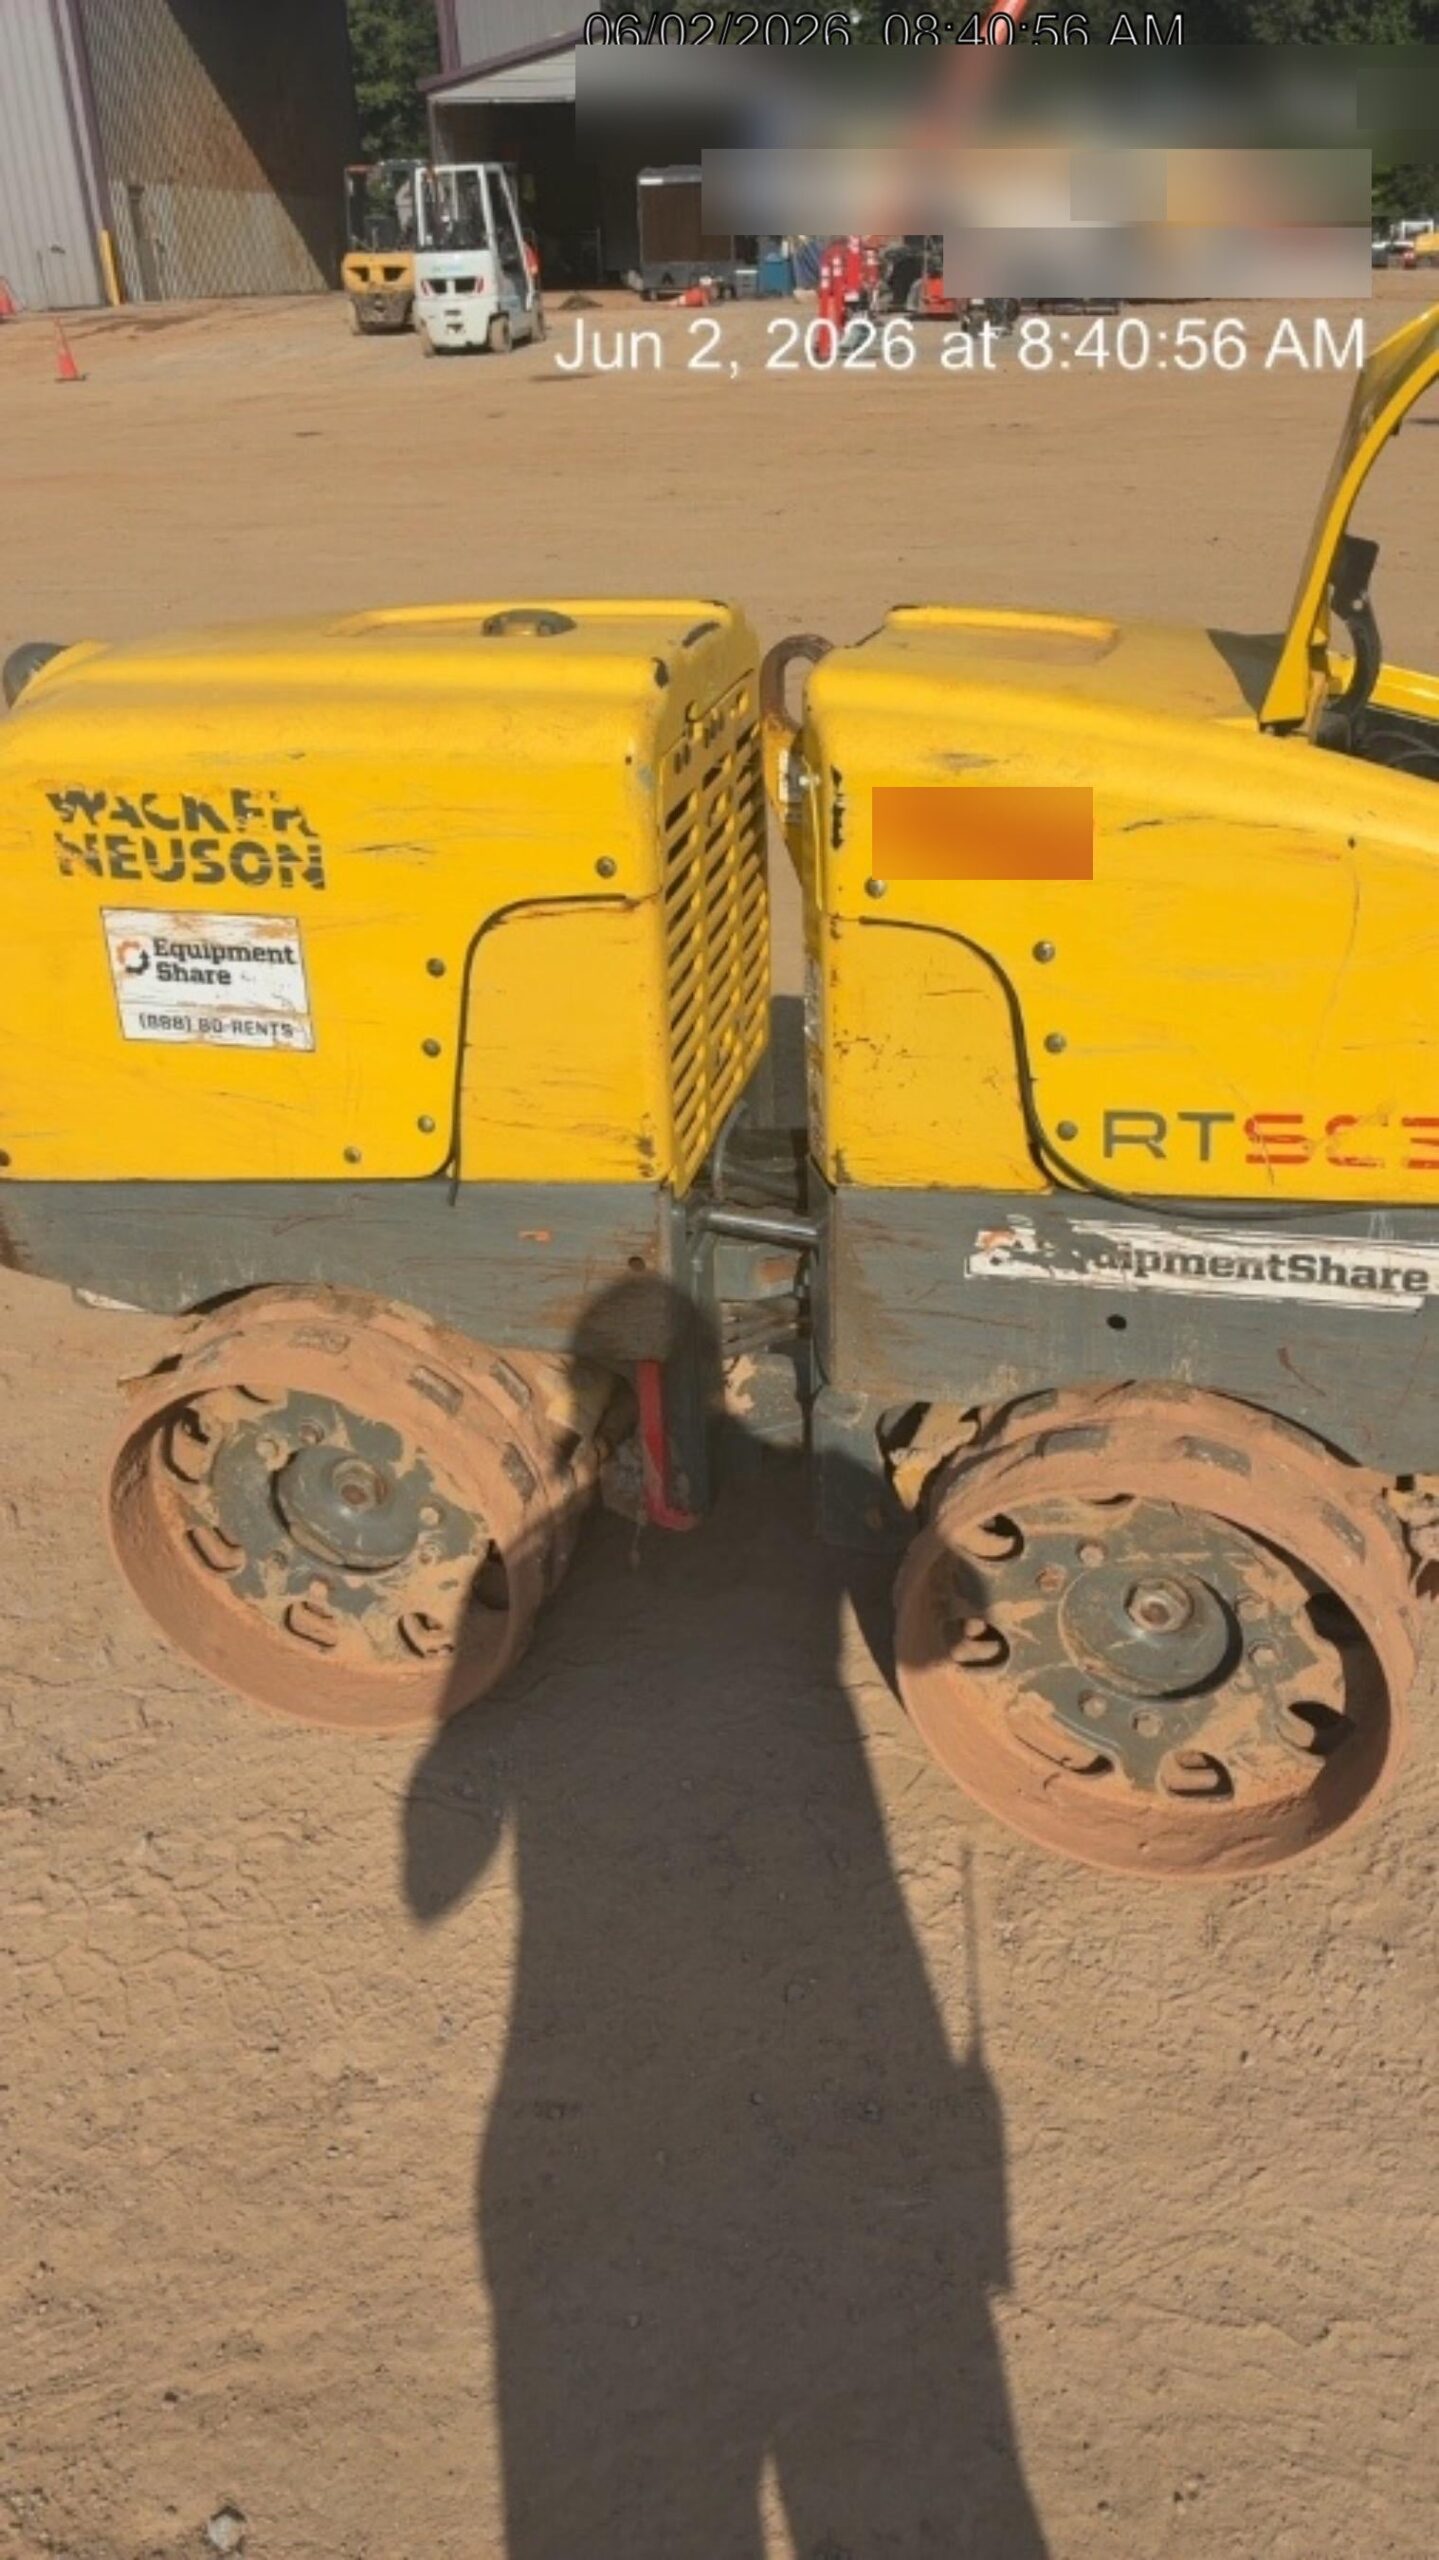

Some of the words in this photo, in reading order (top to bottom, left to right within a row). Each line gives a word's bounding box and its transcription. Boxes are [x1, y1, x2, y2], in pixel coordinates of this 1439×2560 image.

[54, 831, 326, 890] NEUSON
[152, 938, 297, 965] Equipment
[156, 962, 232, 986] Share
[139, 1012, 192, 1033] (888)
